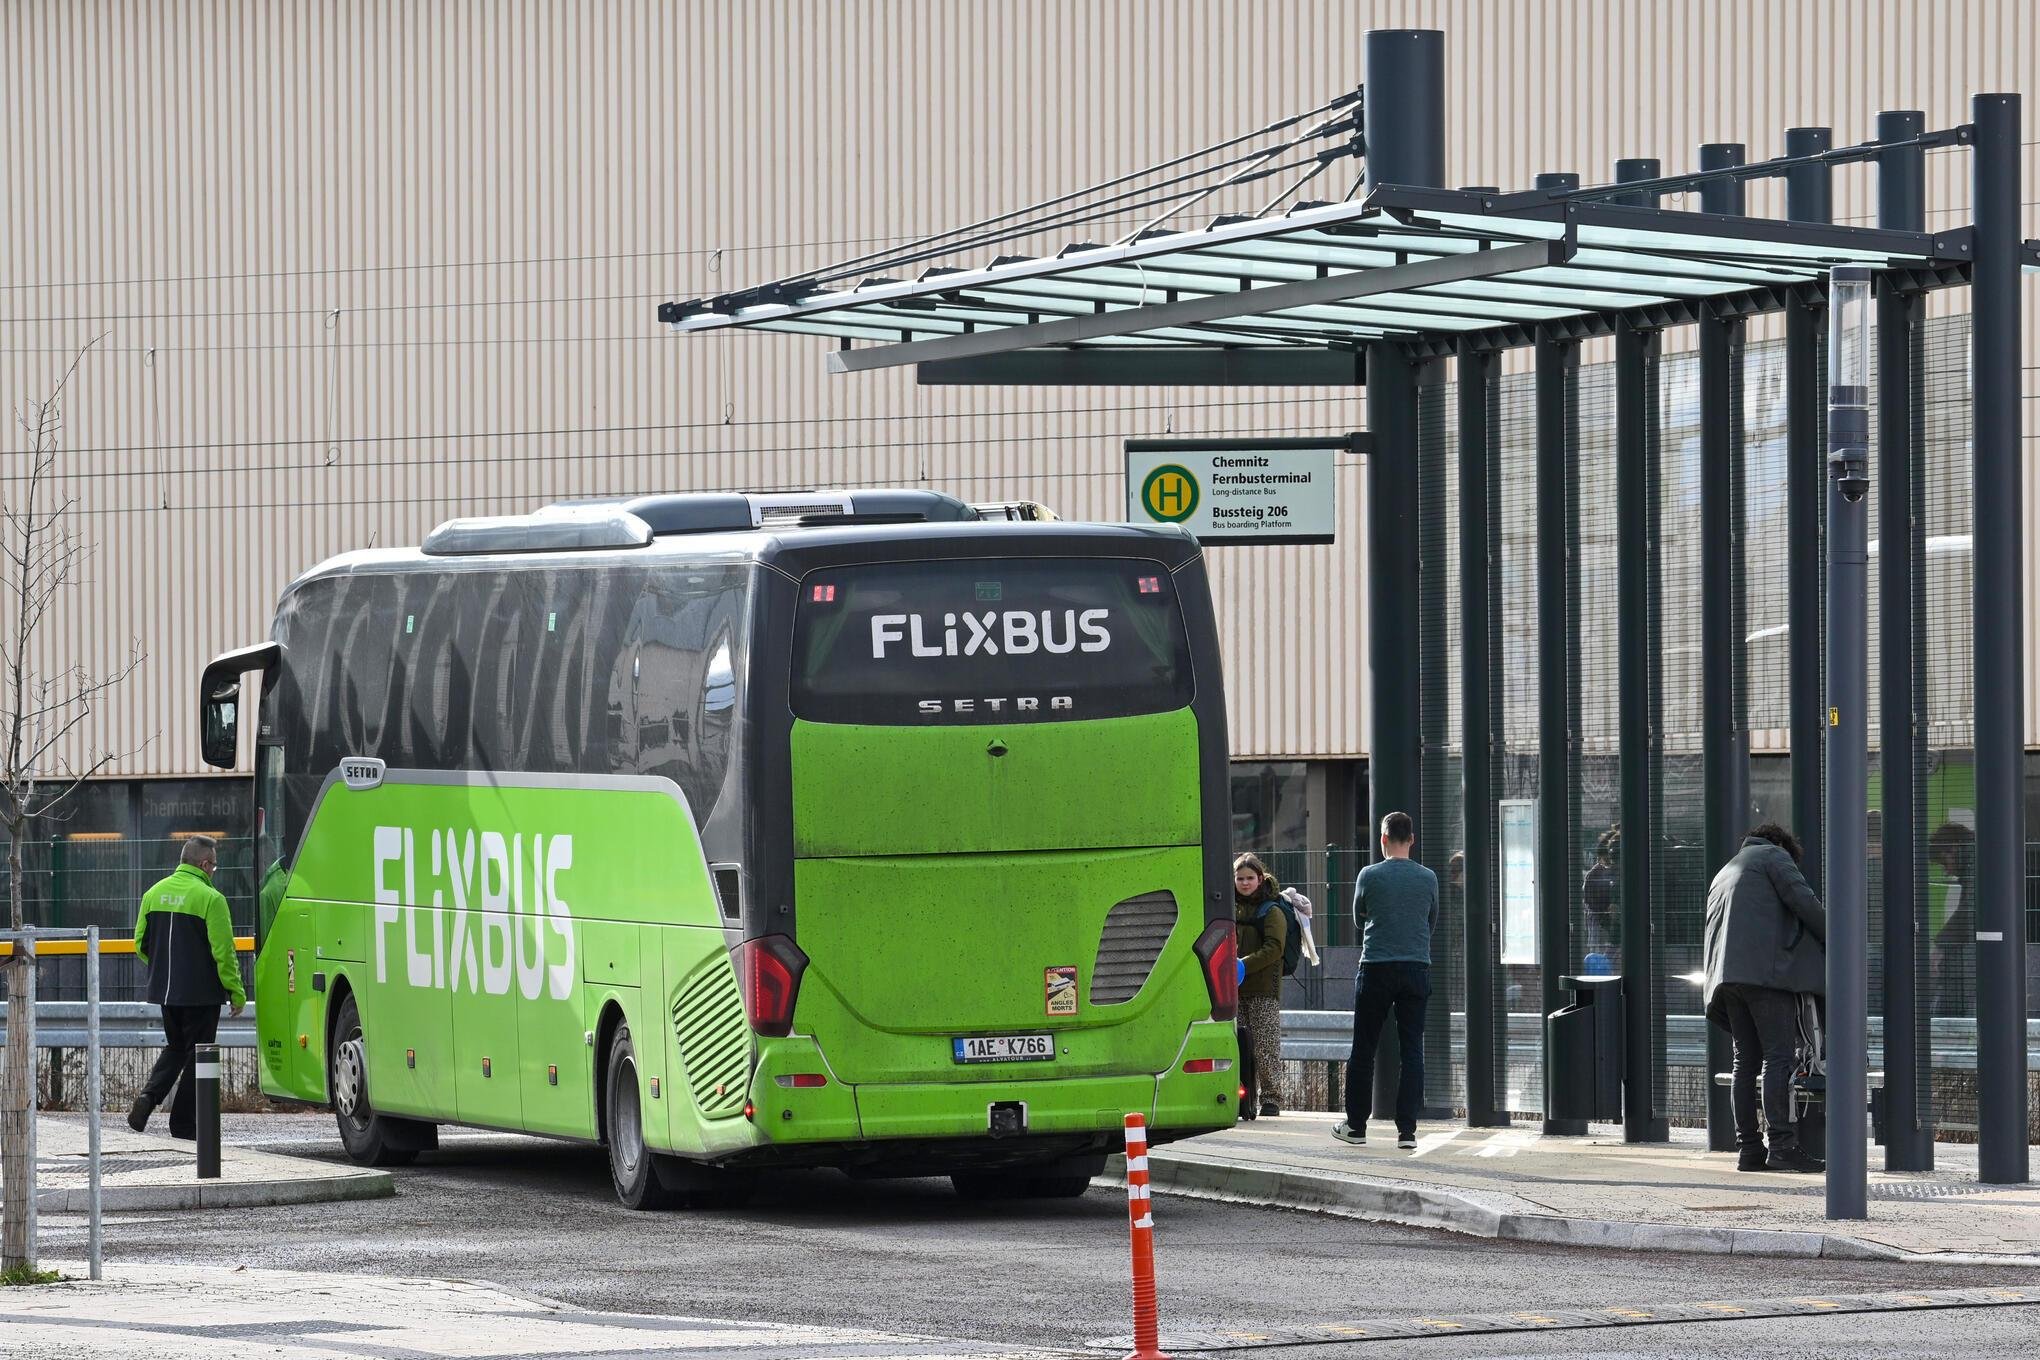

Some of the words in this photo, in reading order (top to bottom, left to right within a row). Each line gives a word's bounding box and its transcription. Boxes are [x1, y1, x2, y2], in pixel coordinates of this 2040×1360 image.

[1212, 456, 1269, 468] Chemnitz
[1212, 472, 1312, 484] Fernbusterminal
[1159, 478, 1183, 511] H
[1212, 488, 1262, 497] Long-distance
[1212, 506, 1264, 519] Bussteig
[1267, 506, 1288, 517] 206
[1227, 521, 1259, 529] boarding
[918, 696, 1073, 714] SETRA
[347, 767, 378, 778] SETRA
[968, 1040, 996, 1056] 1AE
[1008, 1038, 1046, 1055] K766
